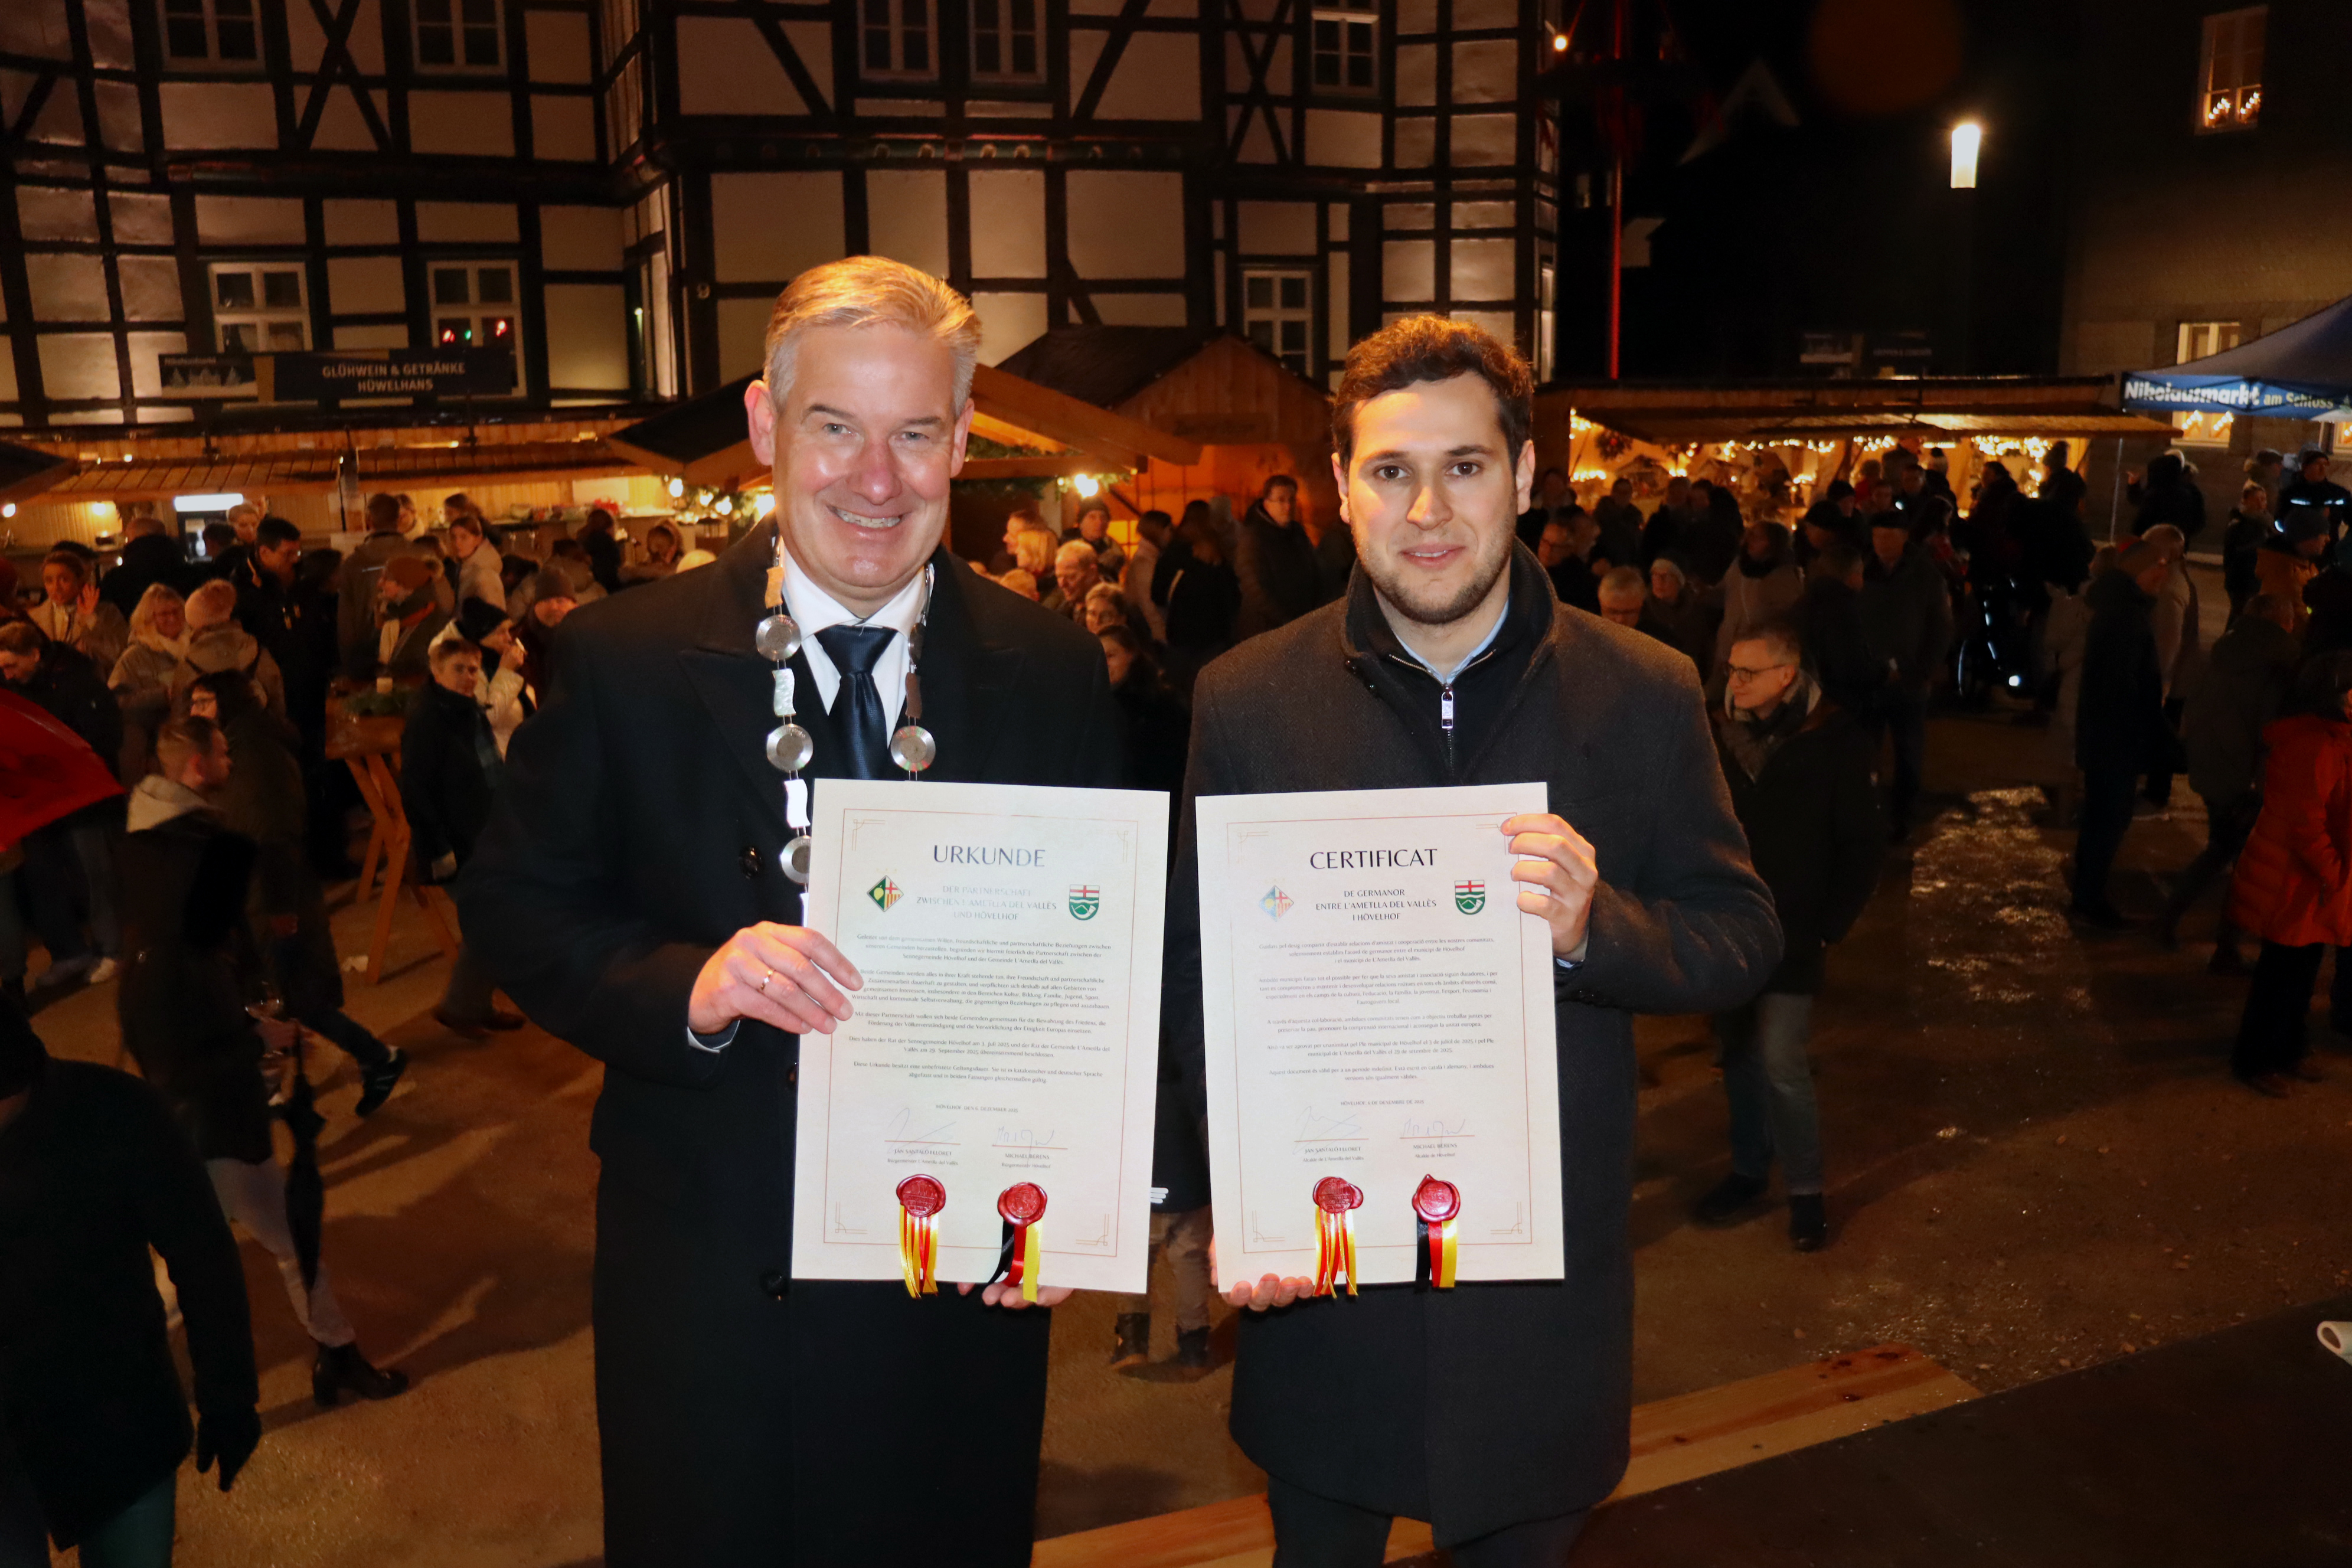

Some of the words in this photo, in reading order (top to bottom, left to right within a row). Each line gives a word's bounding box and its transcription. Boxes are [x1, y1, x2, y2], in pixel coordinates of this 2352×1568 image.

[322, 363, 387, 378] GLÜHWEIN
[391, 365, 400, 375] &
[403, 361, 465, 376] GETRÄNKE
[358, 378, 433, 393] HÜWELHANS
[2263, 394, 2283, 406] am
[934, 844, 1046, 867] URKUNDE
[1310, 848, 1438, 870] CERTIFICAT
[1357, 888, 1404, 897] GERMANOR
[1008, 900, 1025, 909] DEL
[1027, 900, 1057, 910] VALLÈS
[1315, 902, 1341, 910] ENTRE
[1344, 901, 1387, 909] L'AMETLLA
[1406, 899, 1436, 907] VALLÈS
[953, 910, 972, 919] UND
[974, 910, 1020, 921] HÖVELHOF
[1357, 912, 1401, 921] HÖVELHOF
[1060, 976, 1105, 984] partnerschaftliche
[1009, 999, 1042, 1008] Beziehungen
[903, 1021, 955, 1030] Völkerverständigung
